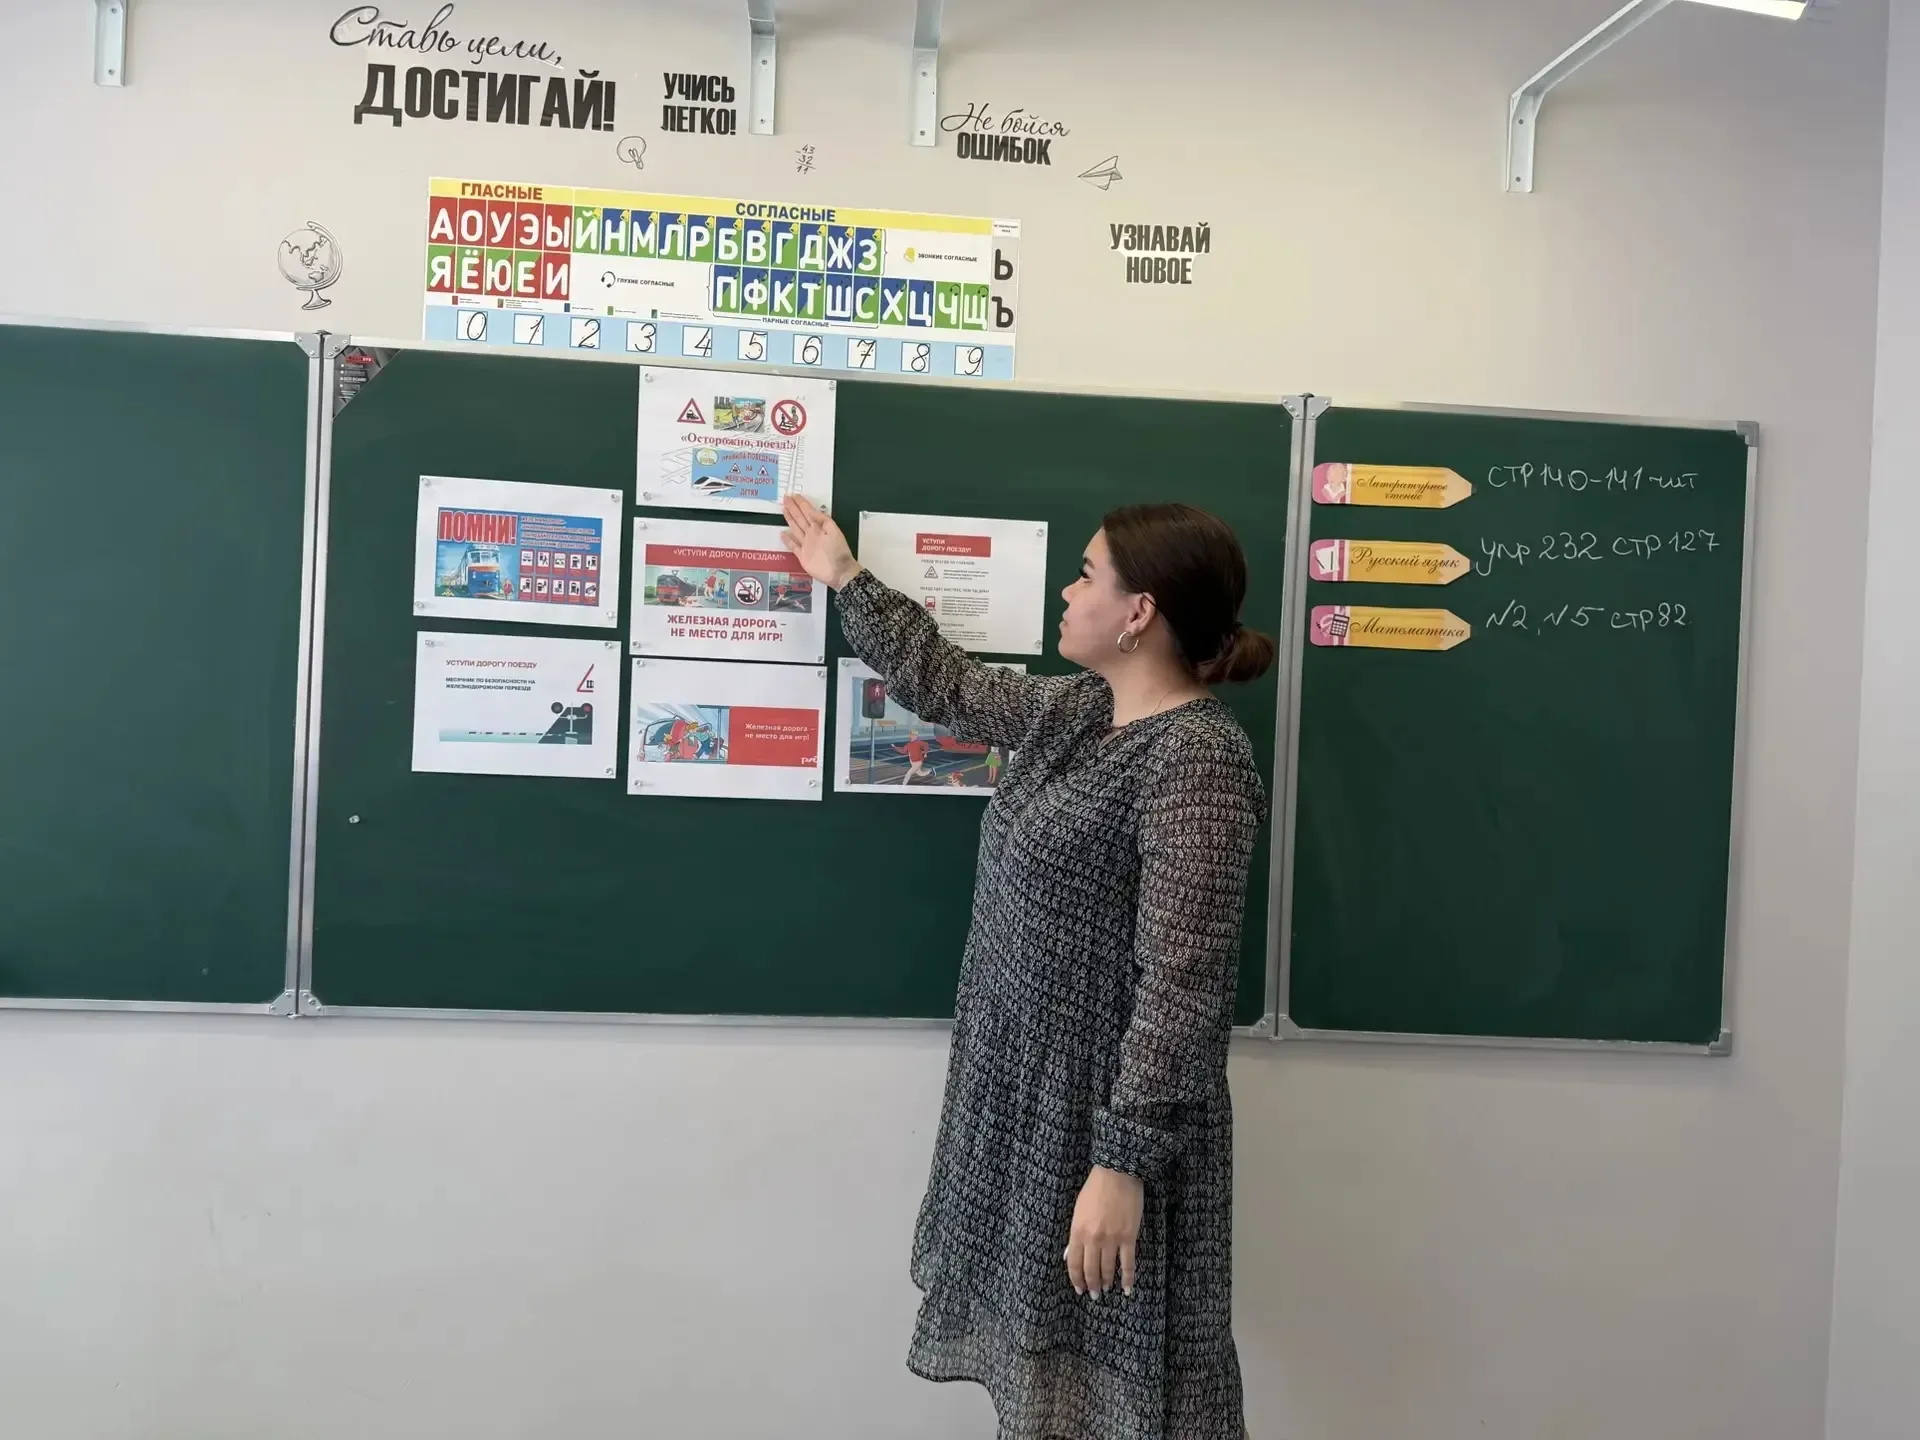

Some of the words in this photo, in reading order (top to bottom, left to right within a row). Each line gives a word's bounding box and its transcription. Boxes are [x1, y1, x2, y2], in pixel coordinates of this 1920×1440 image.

[329, 3, 461, 52] Ставь
[467, 34, 562, 66] цели,
[353, 64, 616, 132] ДОСТИГАЙ!
[663, 72, 735, 103] УЧИСЬ
[660, 105, 737, 136] ЛЕГКО!
[940, 103, 994, 132] Не
[1000, 107, 1071, 137] бойся
[956, 131, 1052, 166] ОШИБОК
[461, 183, 543, 200] ГЛАСНЫЕ
[736, 203, 836, 222] СОГЛАСНЫЕ
[1109, 221, 1211, 254] УЗНАВАЙ
[918, 252, 943, 261] ЗВОНКИЕ
[943, 254, 978, 262] СОГЛАСНЫЕ
[995, 249, 1013, 281] Ь
[617, 277, 638, 286] ГЛУХИЕ
[639, 279, 675, 287] СОГЛАСНЫЕ
[1126, 256, 1192, 285] НОВОЕ
[991, 296, 1014, 328] Ъ
[791, 320, 830, 328] СОГЛАСНЫЕ
[681, 432, 753, 448] «Осторожно,
[757, 439, 796, 450] поезд!»
[1357, 475, 1448, 493] Литературное
[1384, 491, 1423, 501] чтение
[438, 511, 518, 545] ПОМНИ!
[673, 548, 708, 558] «УСТУПИ
[708, 550, 740, 560] ДОРОГУ
[1538, 532, 1603, 560] 232
[1669, 529, 1720, 552] 127
[1351, 546, 1421, 571] Русский
[1421, 558, 1460, 574] язык
[667, 614, 729, 627] ЖЕЛЕЗНАЯ
[732, 617, 778, 629] ДОРОГА
[1658, 601, 1687, 628] 82
[670, 628, 685, 638] НЕ
[688, 629, 728, 640] МЕСТО
[730, 630, 755, 642] ДЛЯ
[758, 632, 783, 643] ИГР!
[1350, 617, 1465, 637] Математика
[476, 660, 506, 668] ДОРОГУ
[507, 661, 537, 669] ПОЕЗДУ
[745, 723, 781, 732] Железная
[782, 725, 808, 733] дорога
